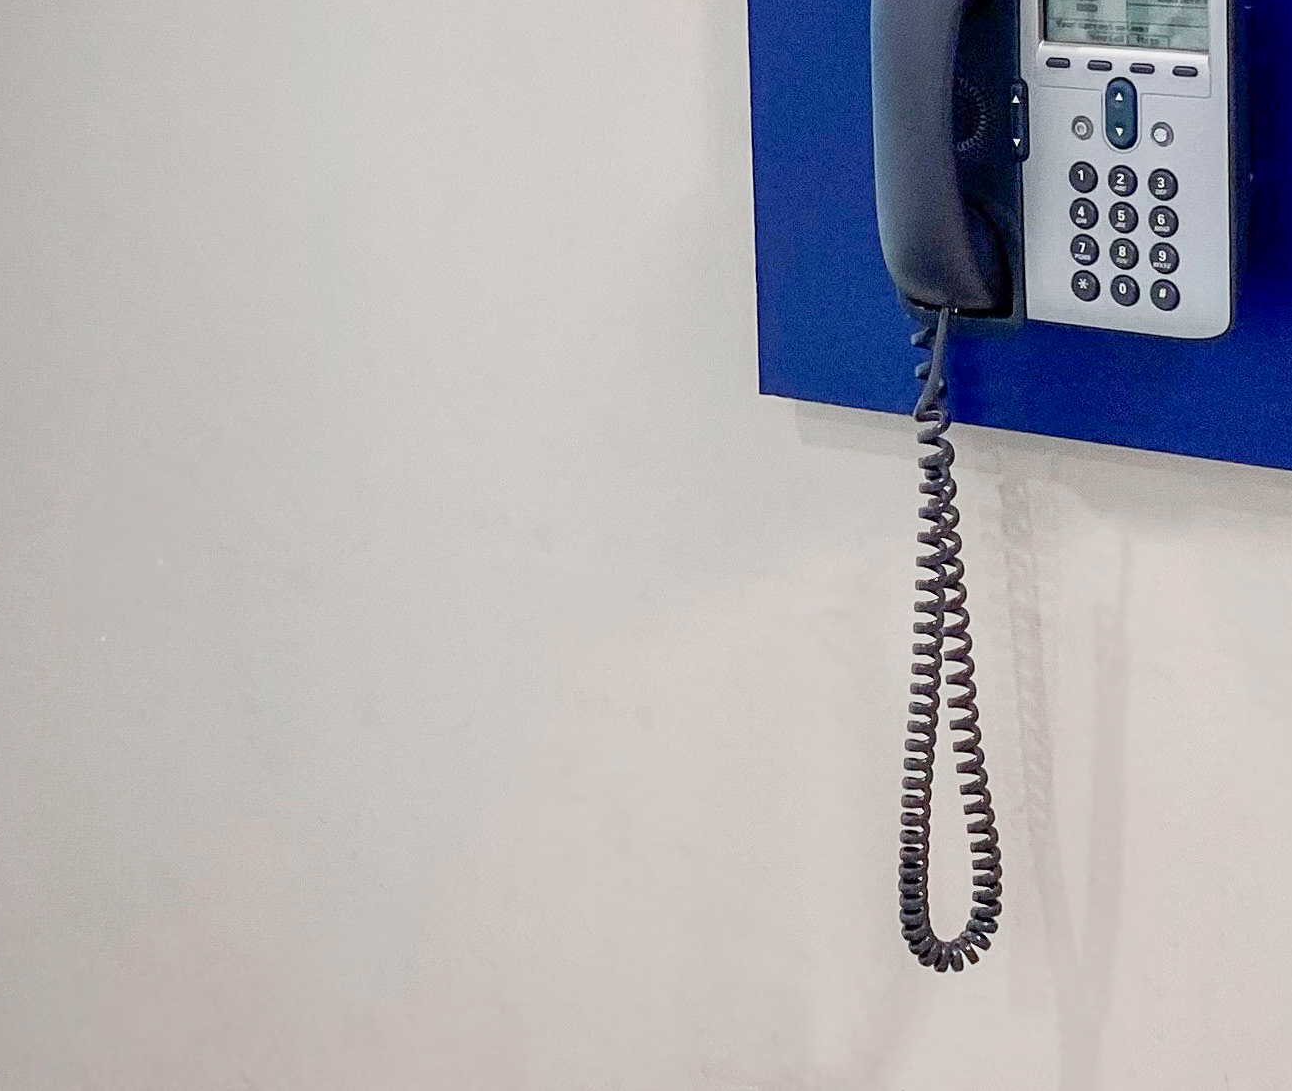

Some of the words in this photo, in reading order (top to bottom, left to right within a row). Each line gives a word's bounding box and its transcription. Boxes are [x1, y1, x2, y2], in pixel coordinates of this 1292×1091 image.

[1077, 169, 1084, 181] 1
[1116, 173, 1125, 185] 2
[1157, 177, 1165, 188] 3
[1077, 206, 1085, 217] 4
[1117, 209, 1126, 221] 5
[1157, 213, 1166, 225] 6
[1078, 242, 1086, 253] 7
[1118, 245, 1127, 257] 8
[1158, 250, 1167, 262] 9
[1118, 283, 1127, 294] 0
